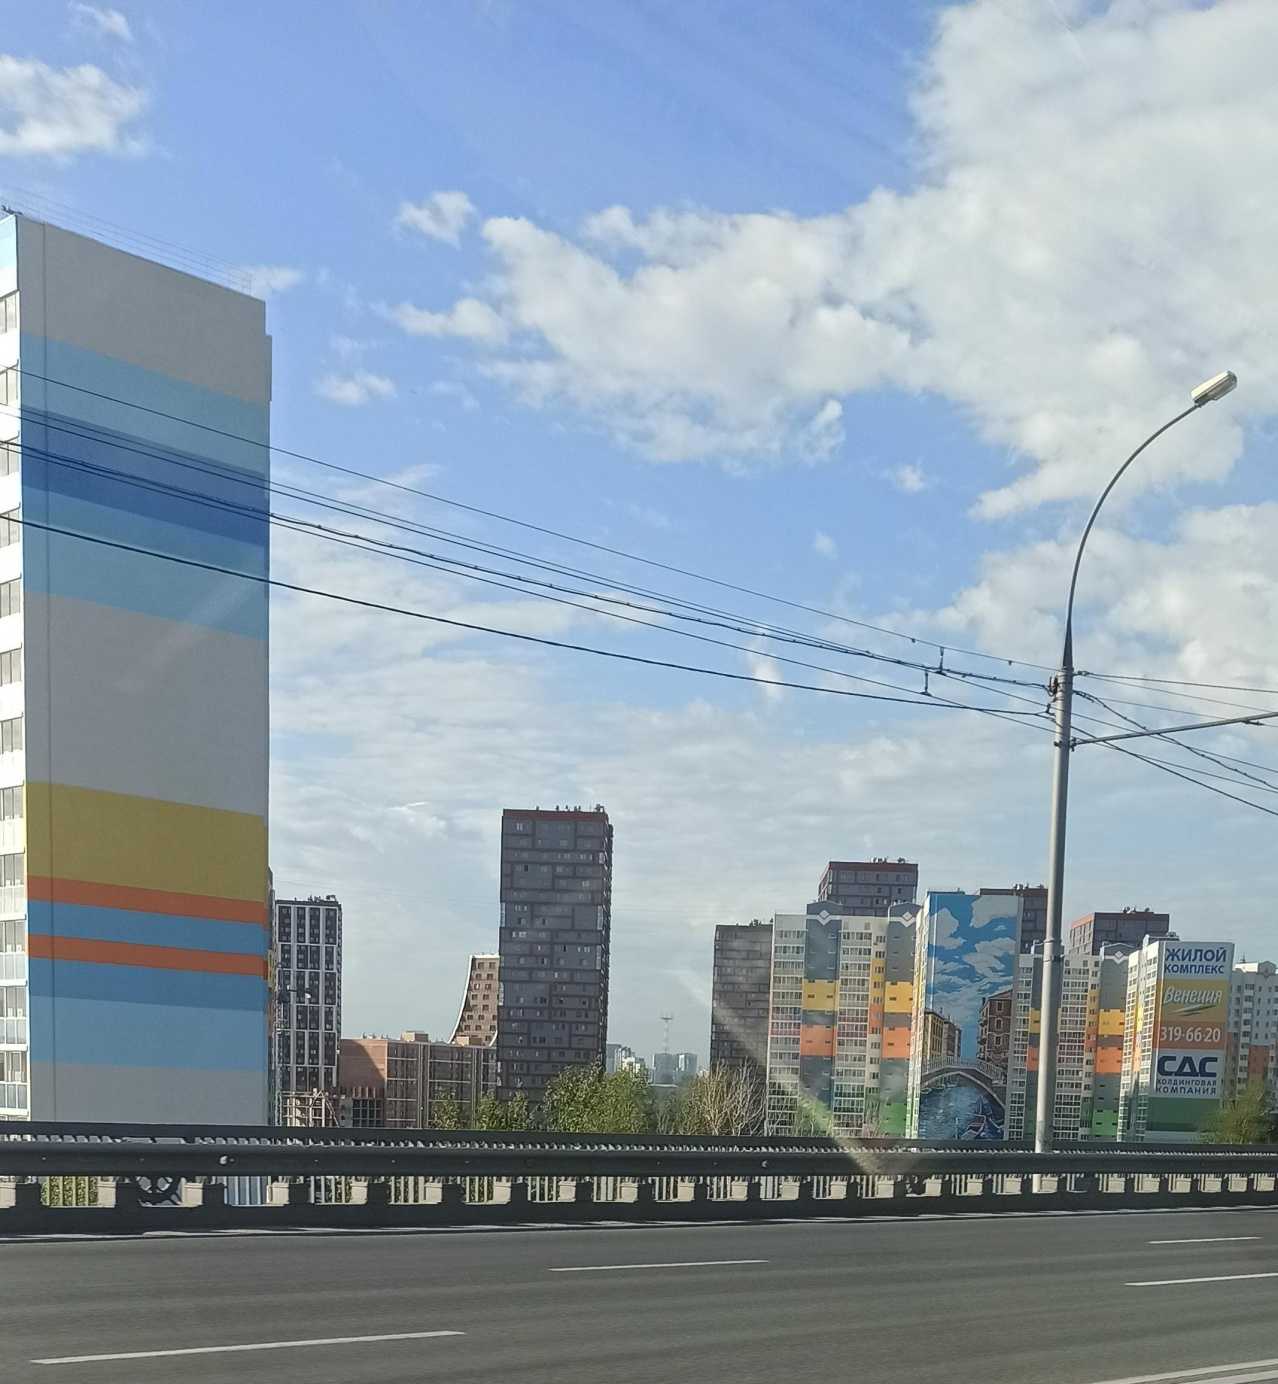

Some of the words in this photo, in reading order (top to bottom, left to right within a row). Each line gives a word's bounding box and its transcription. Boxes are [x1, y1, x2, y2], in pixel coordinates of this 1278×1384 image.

[1166, 947, 1227, 962] ЖИЛОЙ
[1164, 964, 1225, 975] КОМПЛЕКС
[1163, 986, 1223, 1006] Венеция
[1156, 1086, 1216, 1095] КОМПАНИЯ
